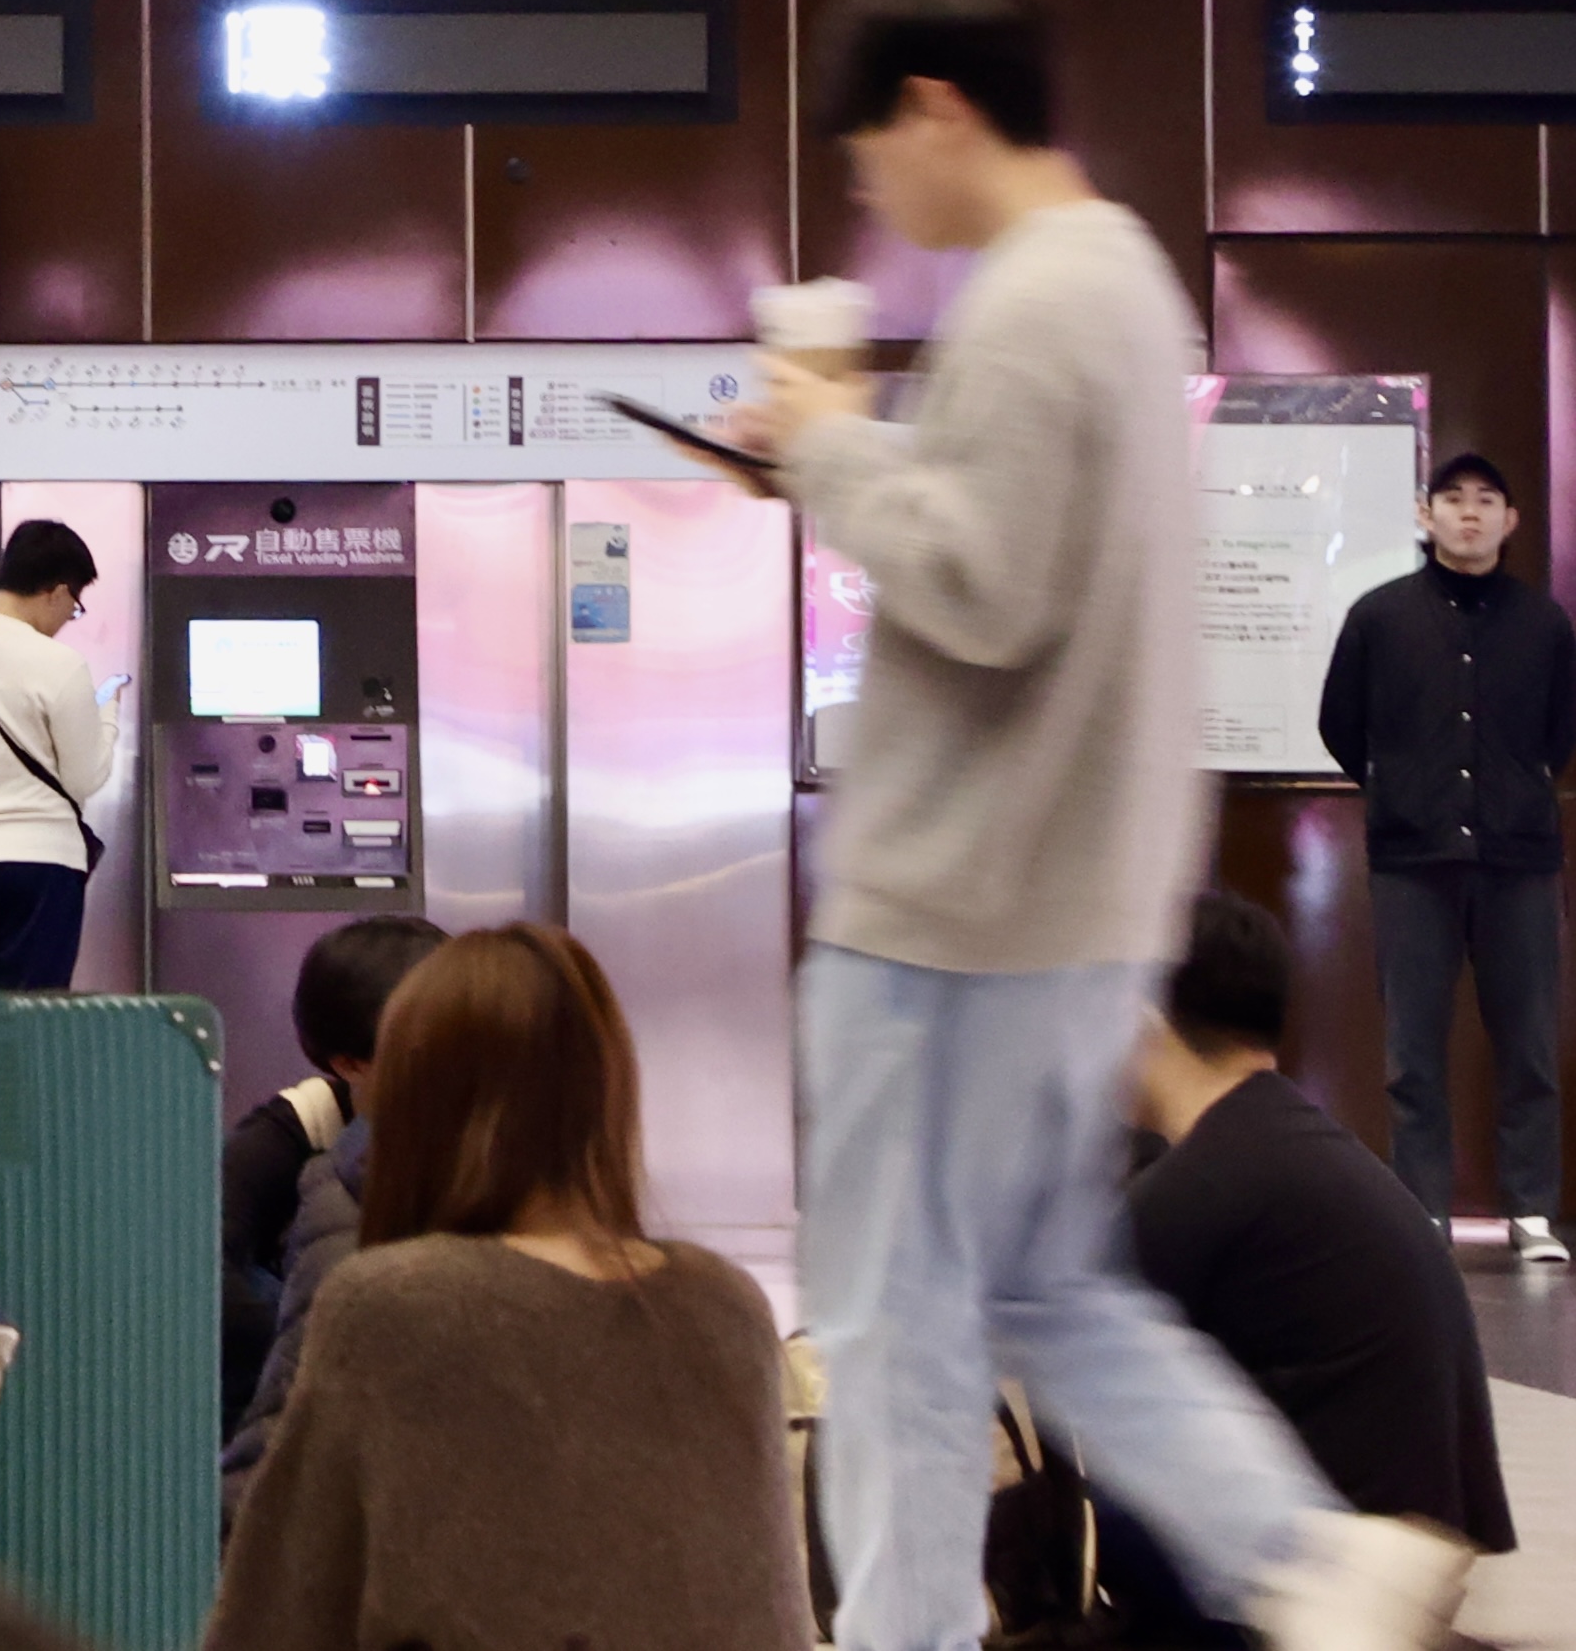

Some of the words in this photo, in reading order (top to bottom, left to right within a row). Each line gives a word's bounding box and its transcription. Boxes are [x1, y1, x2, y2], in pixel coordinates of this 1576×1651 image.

[256, 527, 403, 552] 自動售票機
